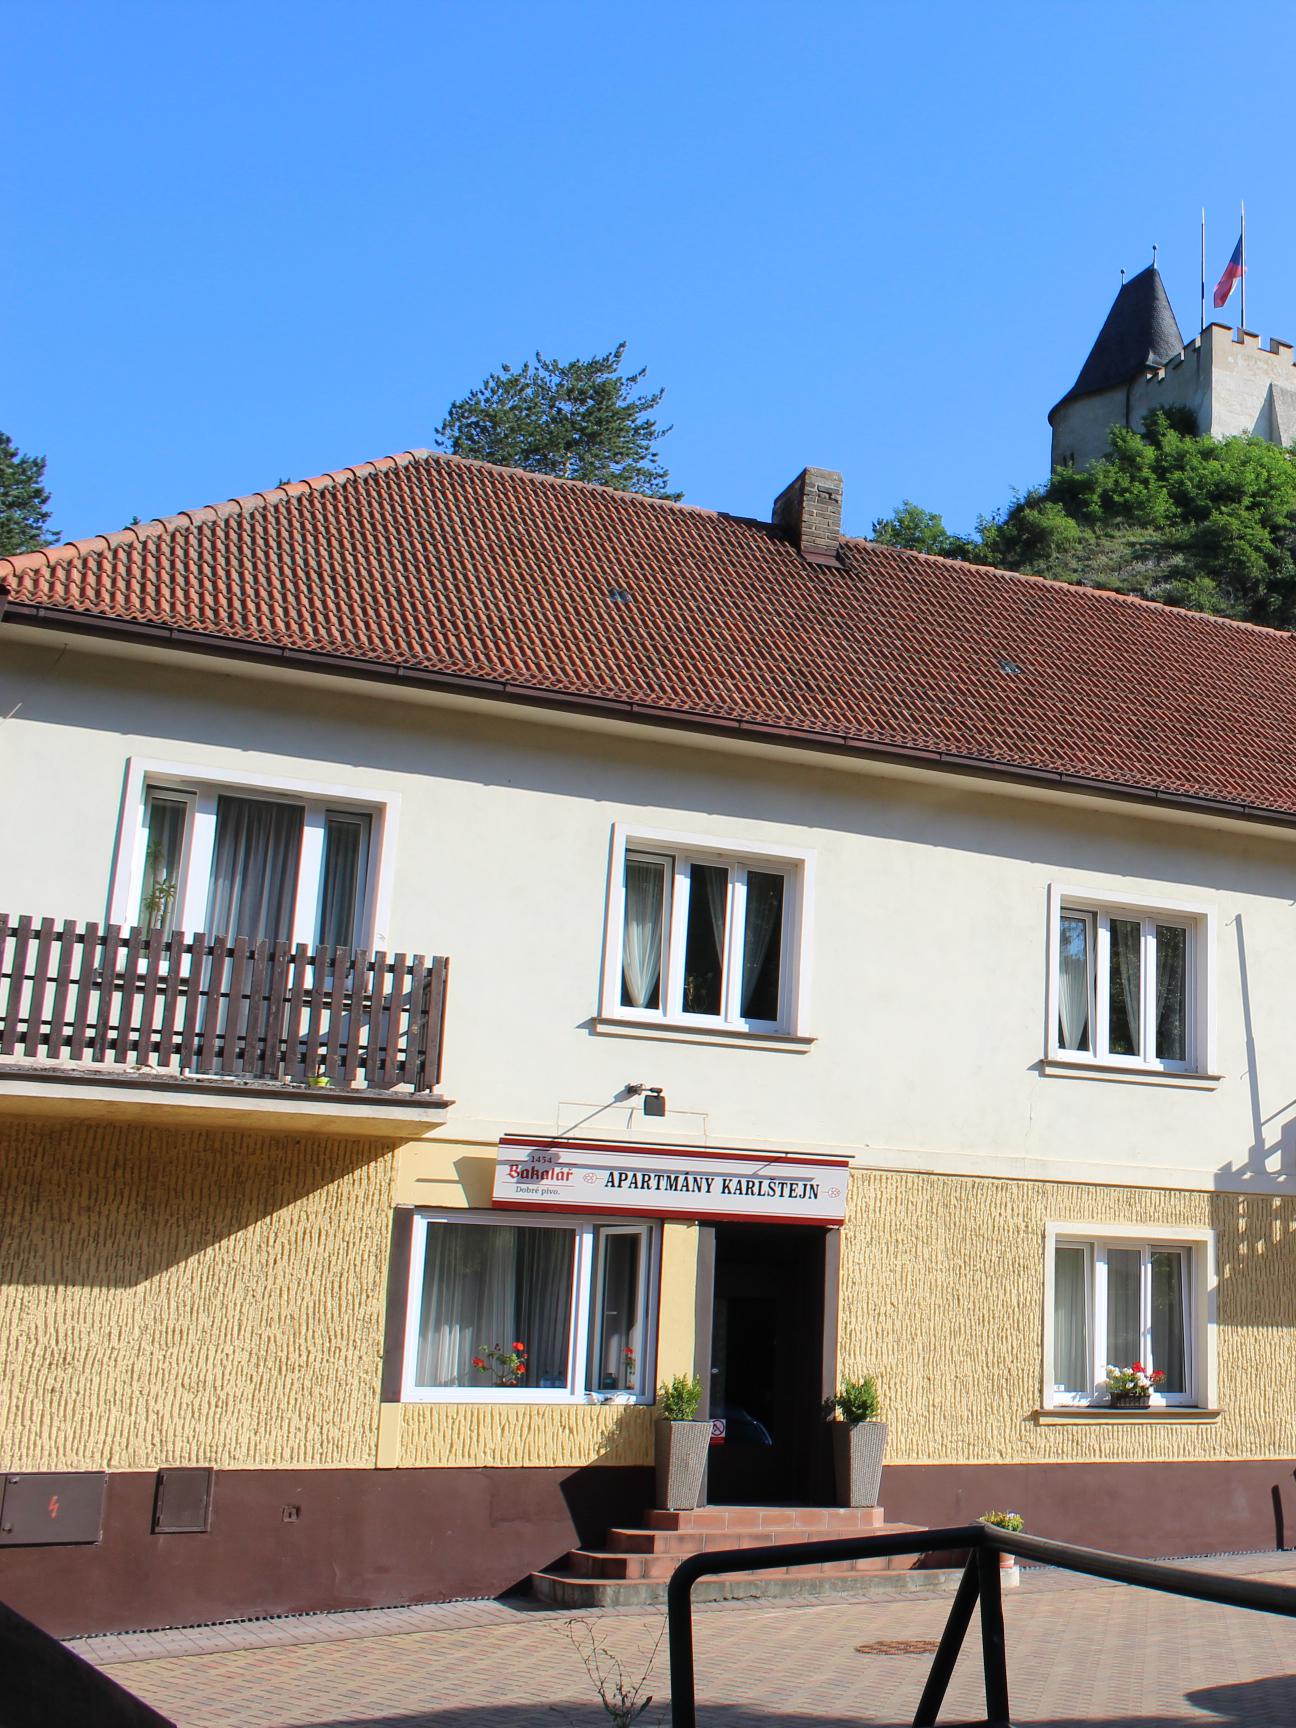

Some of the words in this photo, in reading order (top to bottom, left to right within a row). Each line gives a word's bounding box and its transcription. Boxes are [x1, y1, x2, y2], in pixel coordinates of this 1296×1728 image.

[531, 1155, 552, 1164] 1454
[506, 1164, 574, 1181] Bakalář
[515, 1185, 540, 1194] Dobré
[541, 1188, 561, 1196] pivo.
[604, 1171, 715, 1194] APARTMÁNY
[720, 1178, 820, 1200] KARLŠTEJN
